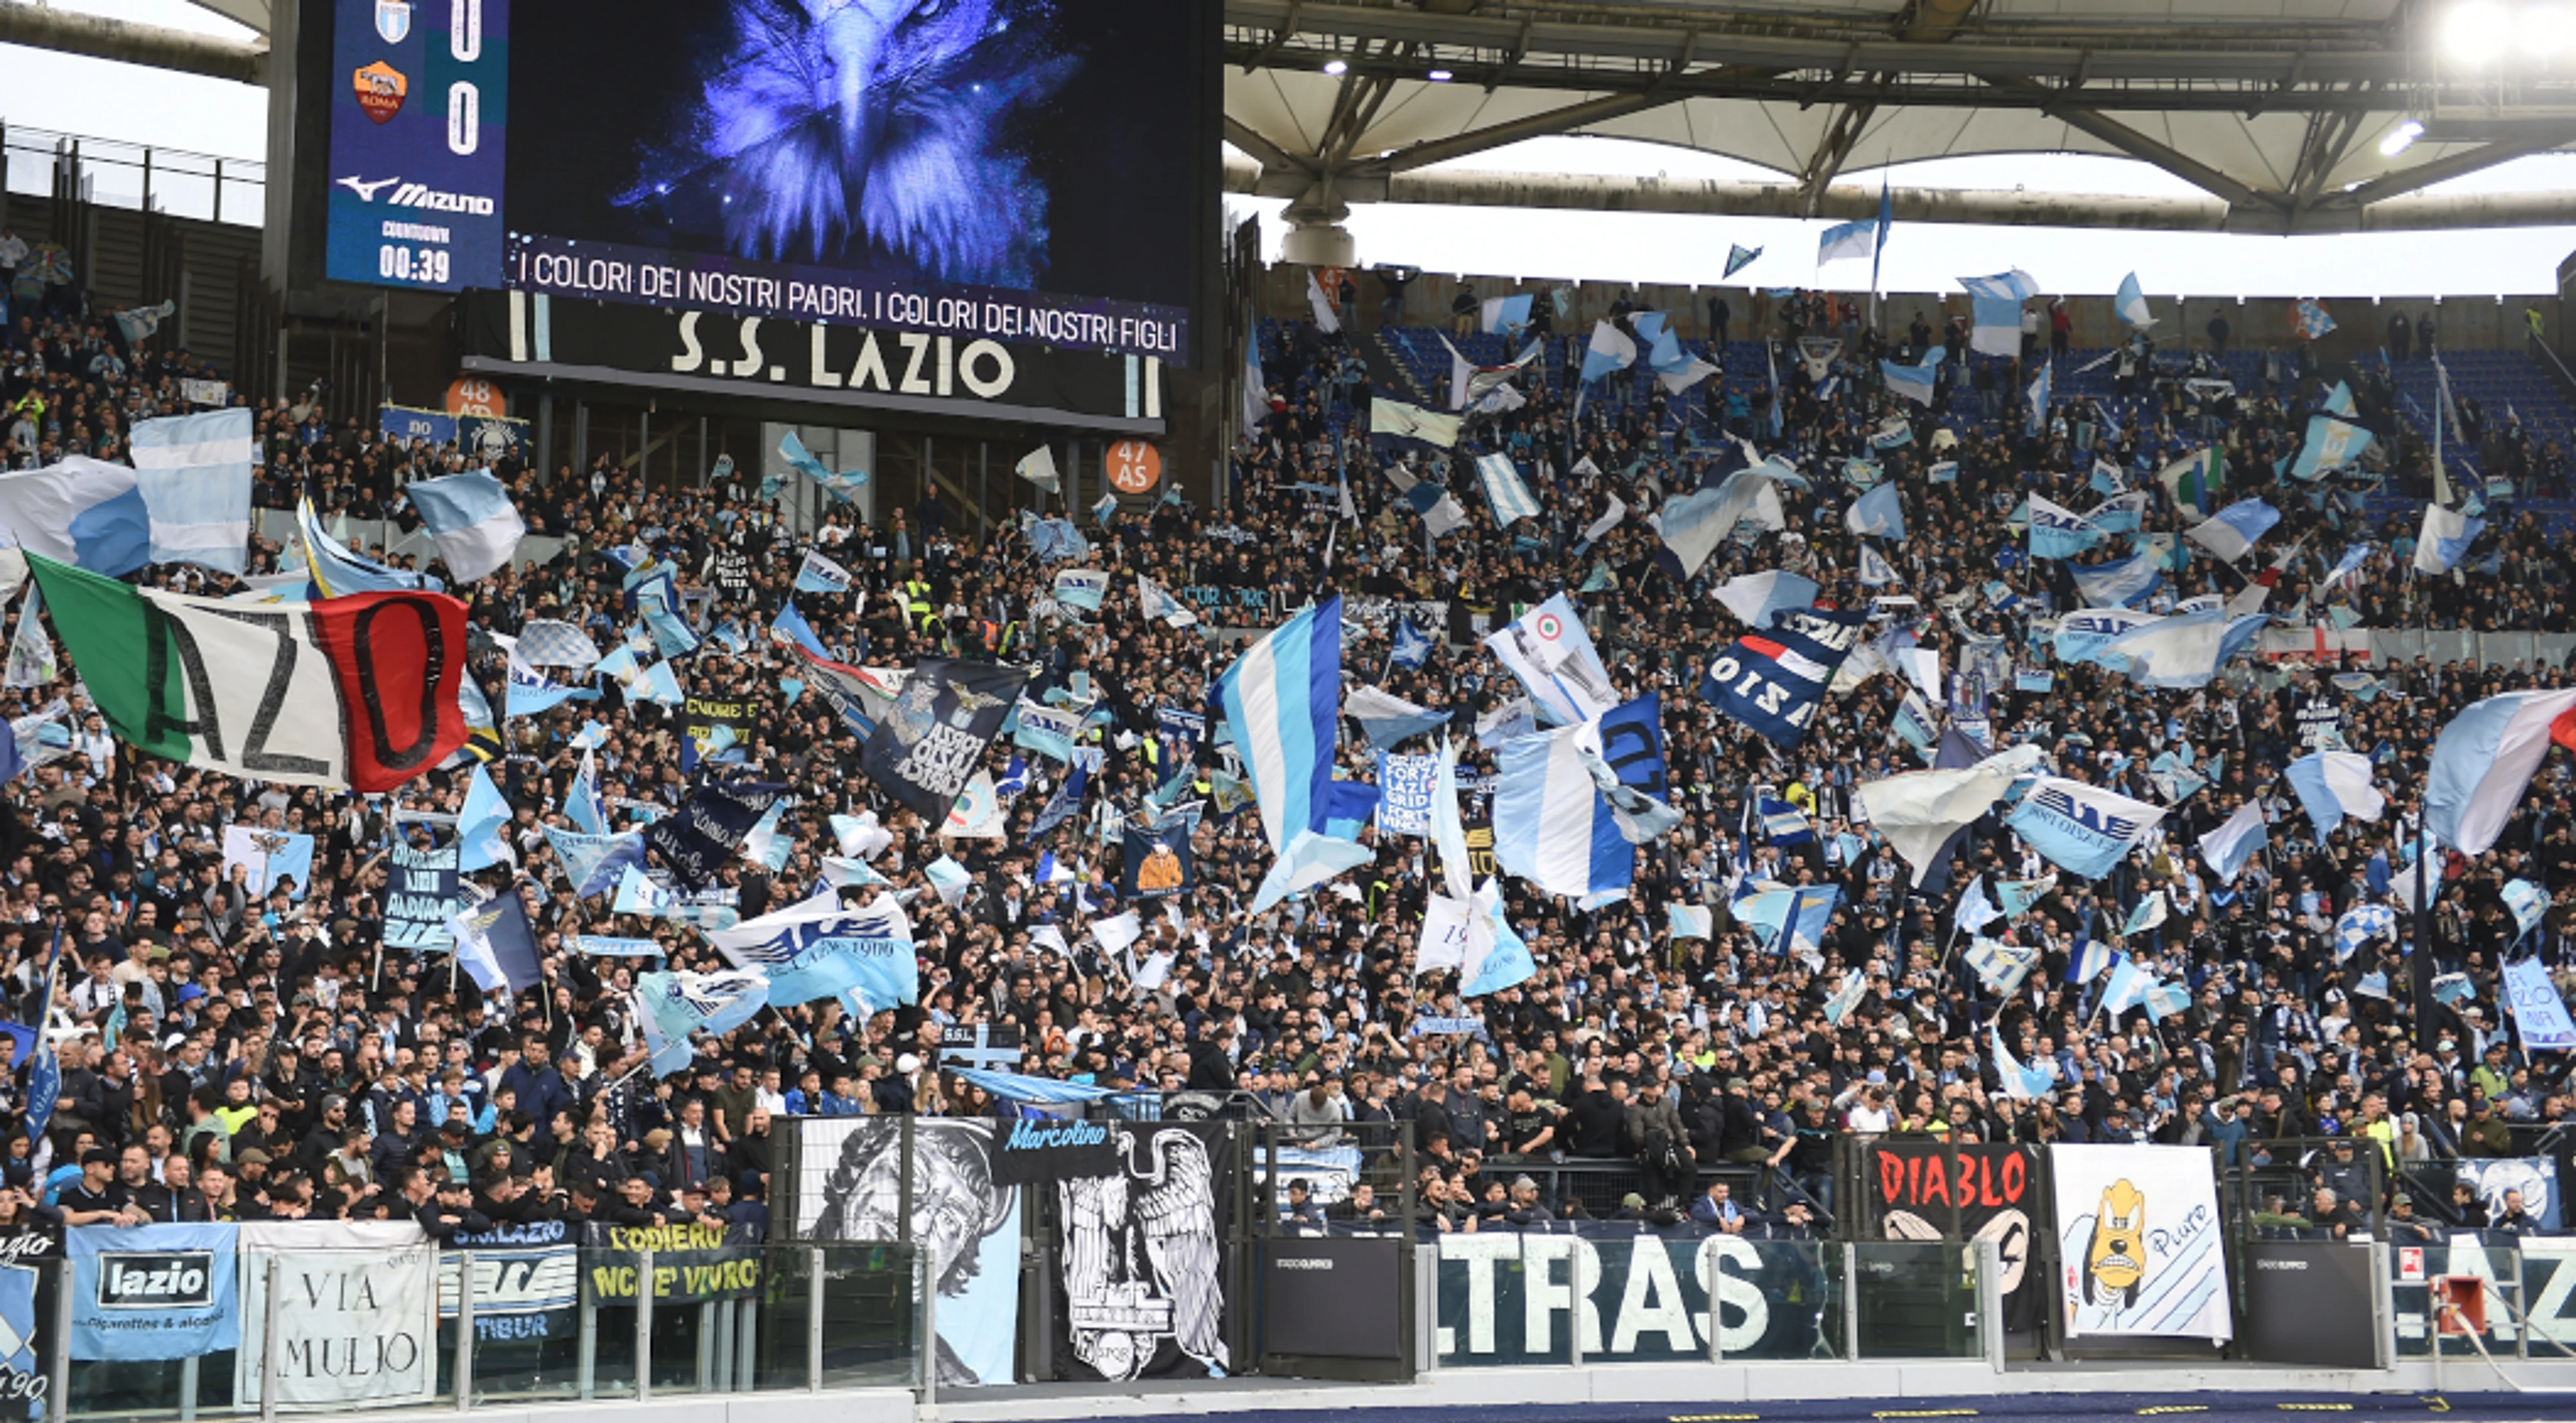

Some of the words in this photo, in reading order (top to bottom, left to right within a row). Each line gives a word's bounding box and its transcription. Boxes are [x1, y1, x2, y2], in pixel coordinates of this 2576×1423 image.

[360, 94, 398, 109] ROMA
[448, 81, 479, 155] 0
[380, 244, 449, 283] 00:39
[519, 252, 527, 283] I
[534, 252, 632, 294] COLORI
[641, 264, 682, 299] DEI
[688, 270, 781, 310] NOSTRI
[875, 291, 882, 321] I
[888, 292, 977, 330] COLORI
[985, 303, 1022, 335] DEI
[1030, 308, 1114, 344] NOSTRI
[1120, 317, 1177, 352] FIGLI
[811, 323, 1016, 399] LAZIO
[460, 379, 491, 403] 48
[1118, 441, 1147, 464] 47
[1117, 465, 1148, 487] AS
[101, 592, 444, 777] AZIO
[1386, 790, 1429, 806] GRID
[1004, 1118, 1108, 1151] Marcolino
[1877, 1151, 2025, 1208] DIABLO
[110, 1261, 204, 1295] lazio
[302, 1273, 380, 1311] VIA
[475, 1314, 548, 1340] TIBUR
